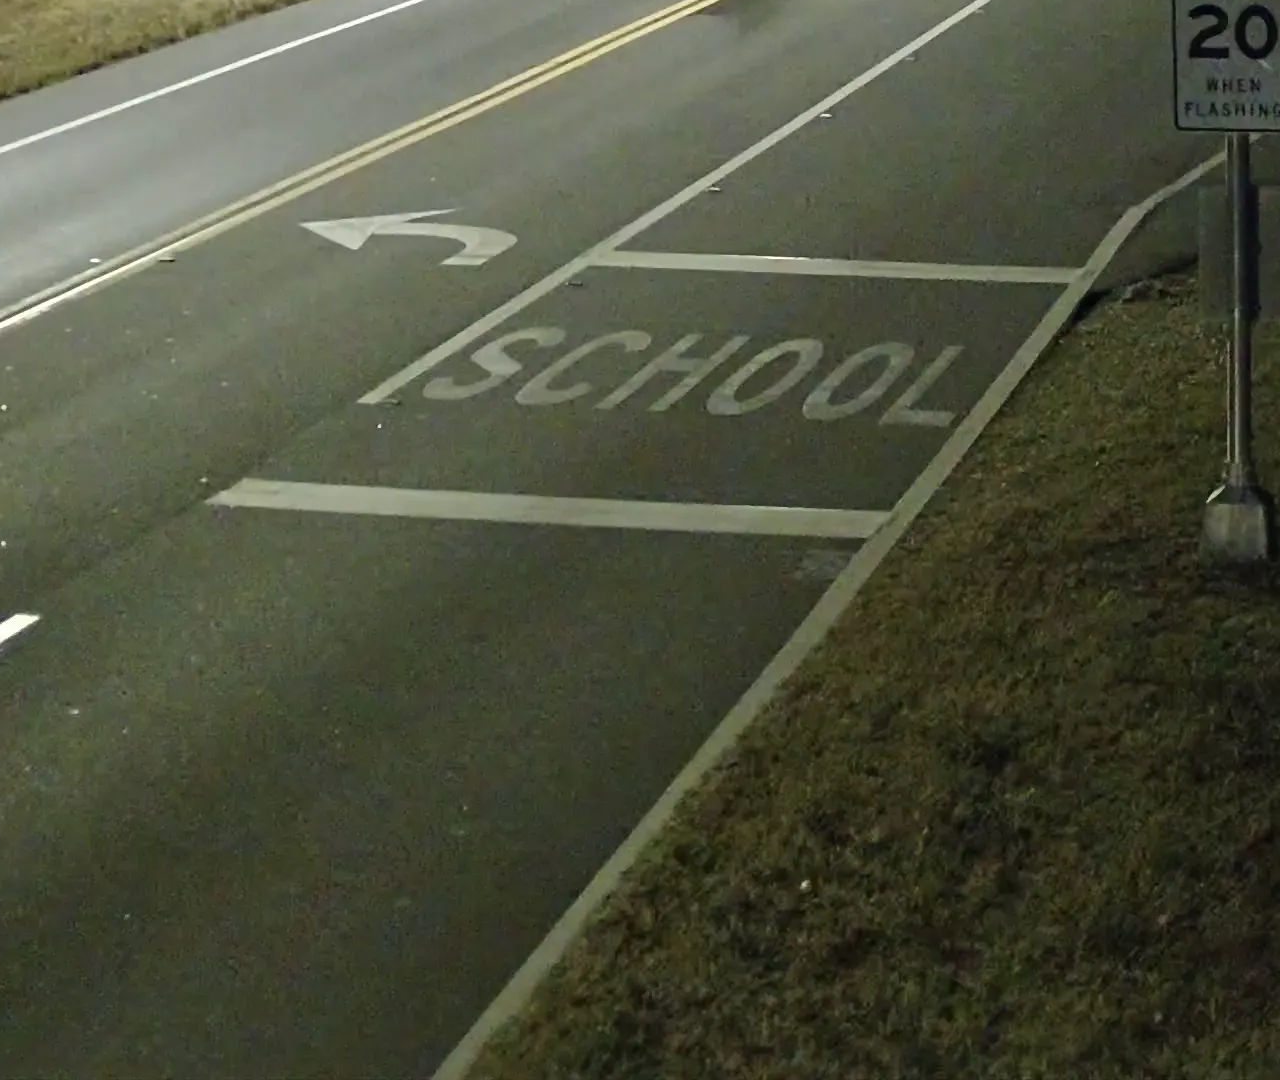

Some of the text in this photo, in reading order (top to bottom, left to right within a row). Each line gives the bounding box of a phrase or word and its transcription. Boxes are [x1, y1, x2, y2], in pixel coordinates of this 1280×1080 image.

[1188, 4, 1279, 60] 20
[1206, 78, 1262, 93] WHEN
[422, 326, 964, 428] SCHOOL
